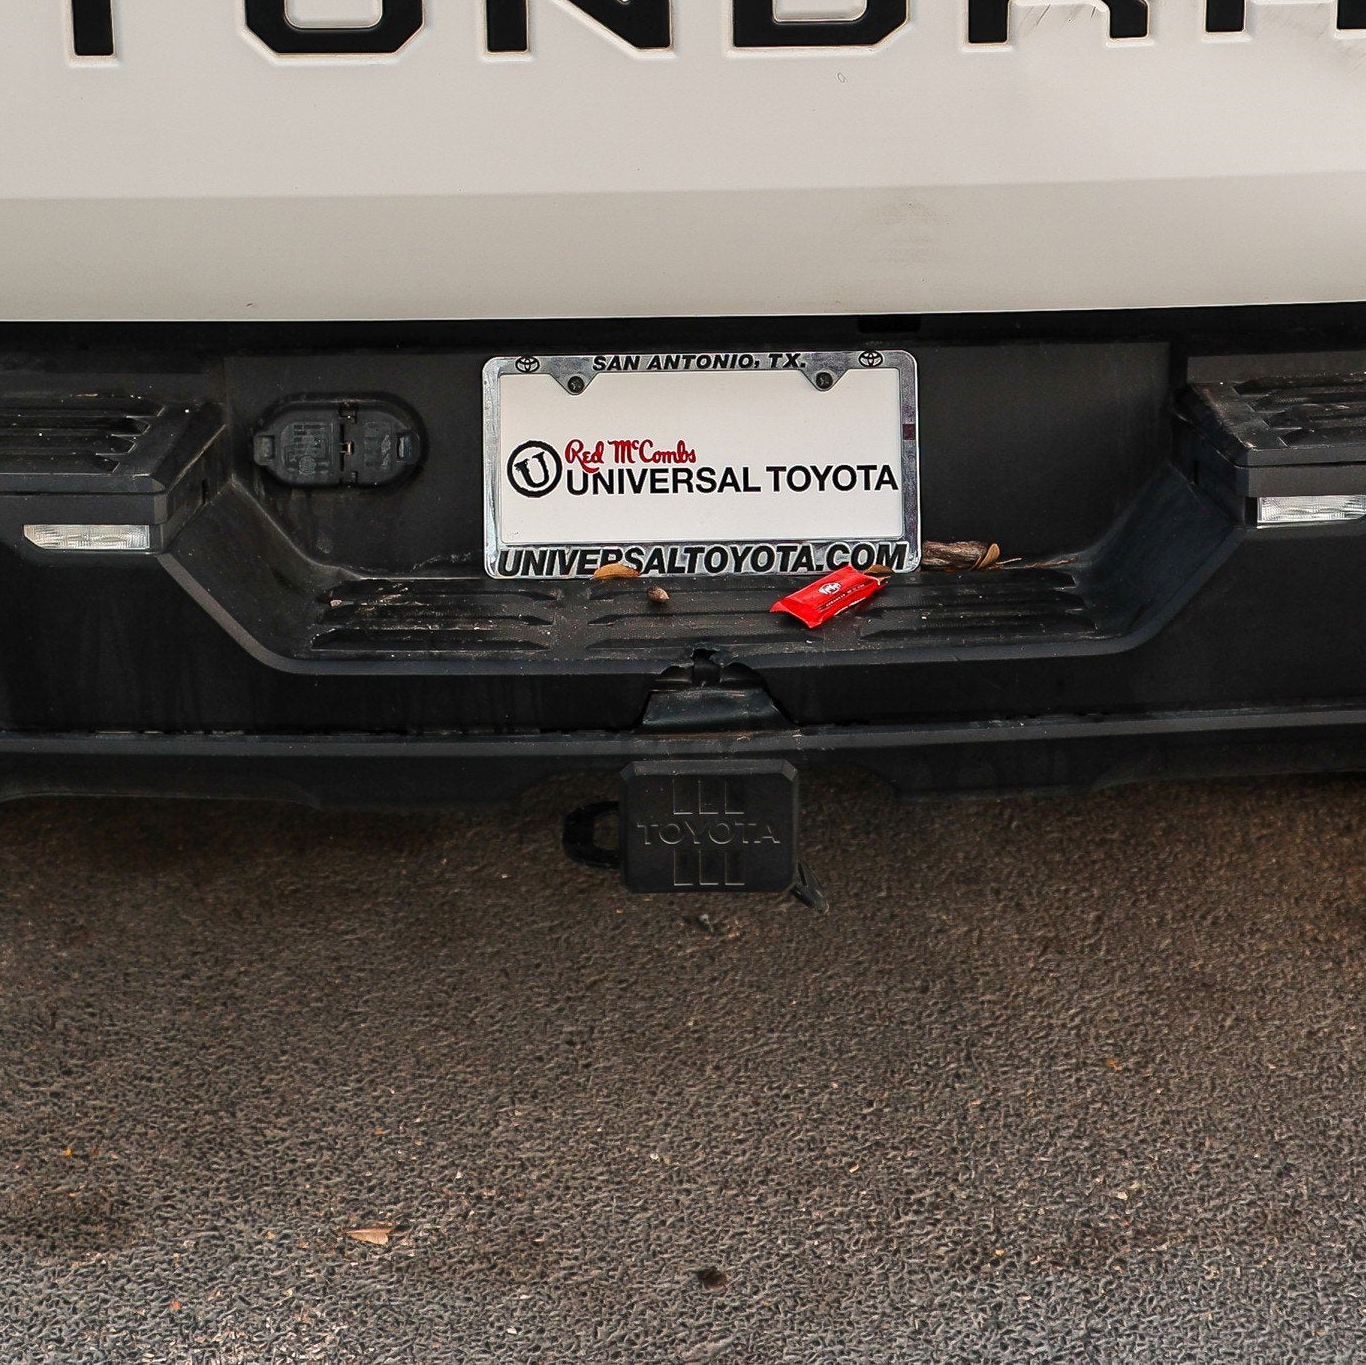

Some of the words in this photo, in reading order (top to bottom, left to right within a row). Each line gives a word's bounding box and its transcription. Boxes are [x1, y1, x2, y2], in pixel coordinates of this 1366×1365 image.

[592, 355, 640, 371] SAN
[647, 353, 760, 370] ANTONIO,
[768, 353, 807, 368] TX.
[564, 439, 605, 473] Red
[566, 466, 761, 495] UNIVERSAL
[766, 464, 900, 493] TOYOTA
[636, 822, 781, 845] TOYOTA
